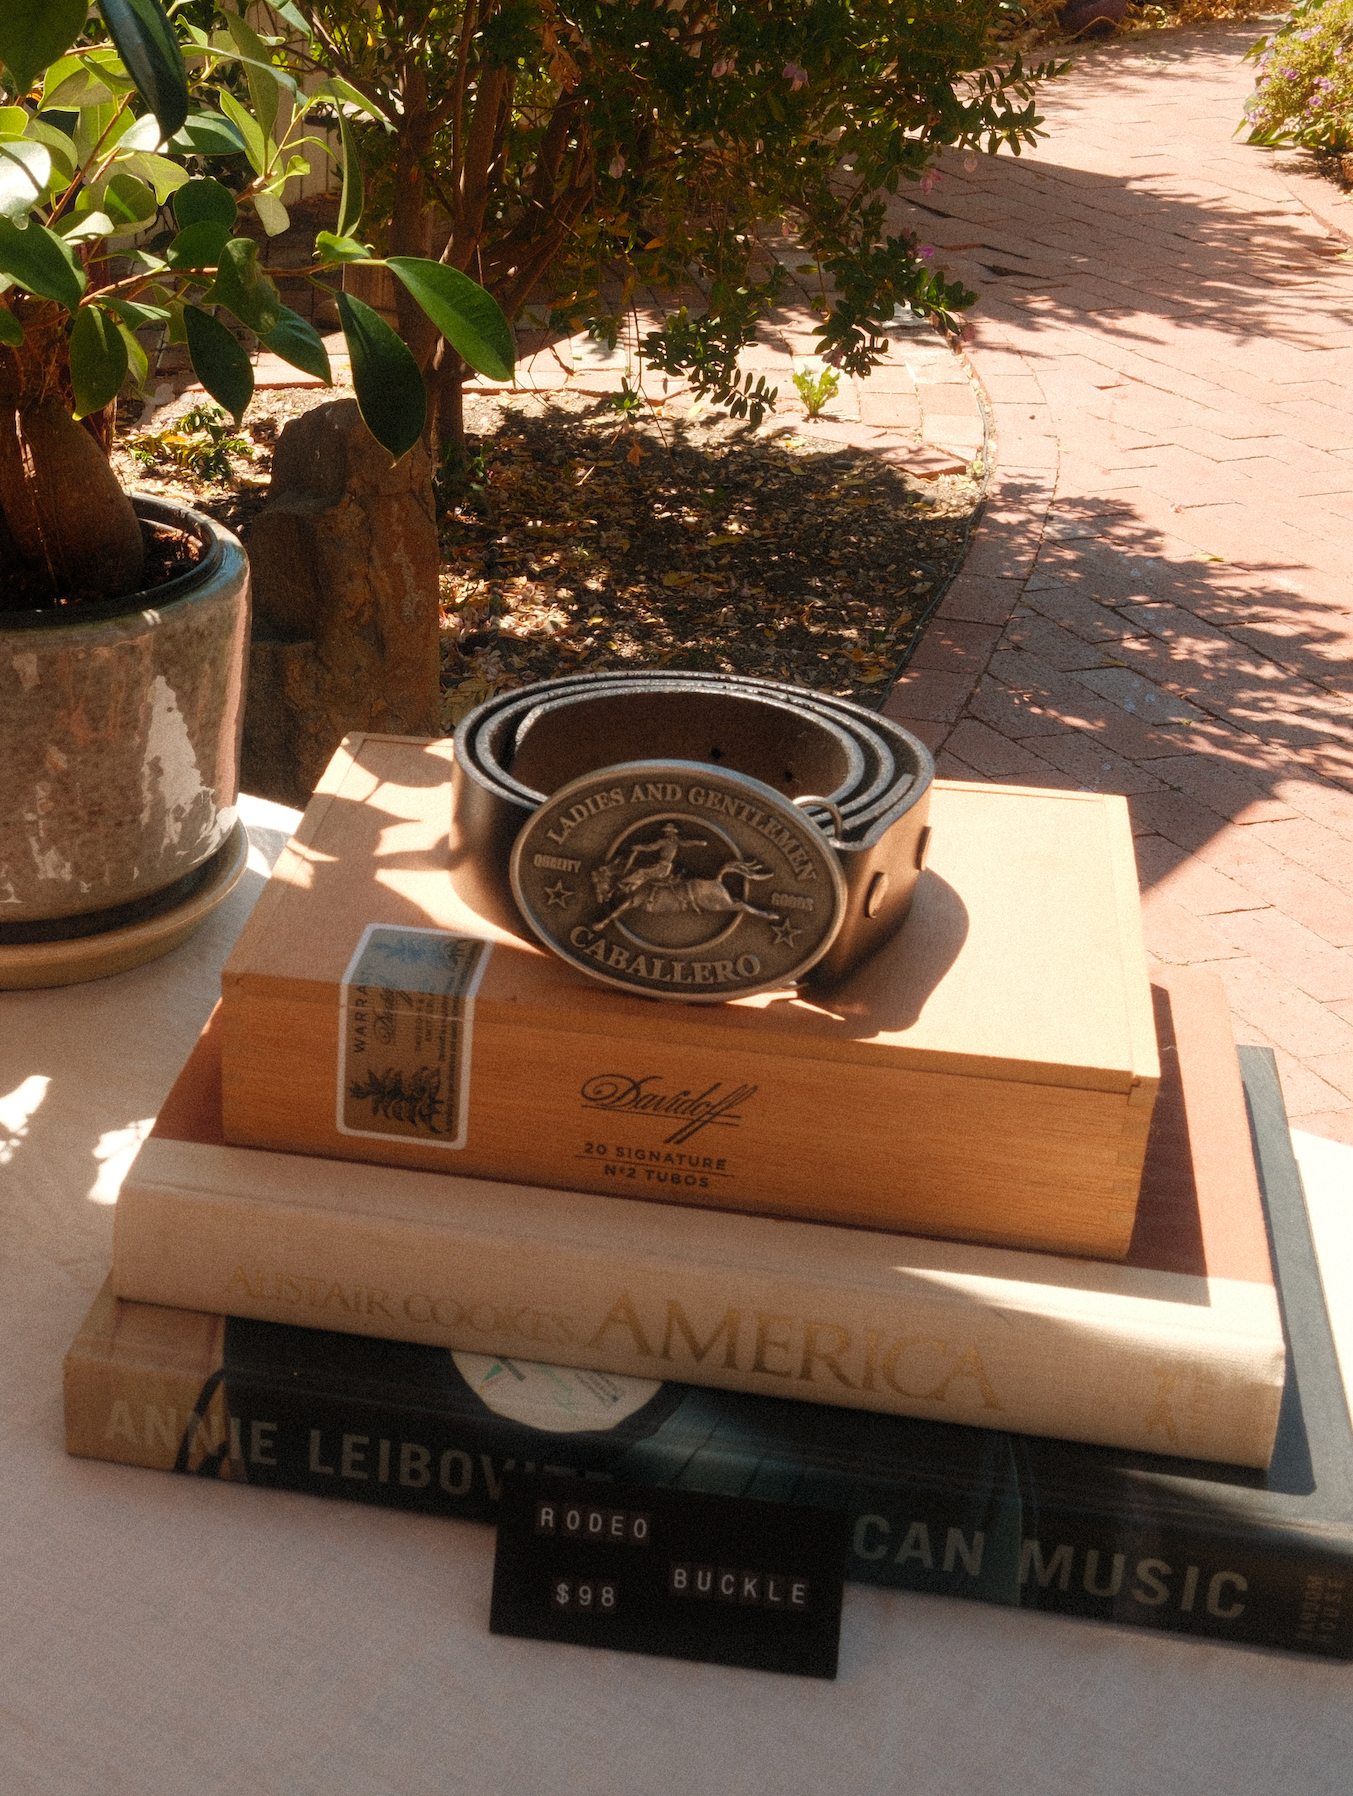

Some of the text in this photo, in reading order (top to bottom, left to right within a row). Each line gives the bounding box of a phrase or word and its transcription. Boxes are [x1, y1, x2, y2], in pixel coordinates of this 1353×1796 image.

[546, 782, 818, 883] LADIES AND GENTLEMEN
[568, 925, 762, 986] CABALLERO
[580, 1073, 759, 1146] Davidoff
[584, 1142, 728, 1171] 20 SIGNATURE
[645, 1168, 710, 1188] TUBOS
[225, 1265, 395, 1321] ALISTAIR
[585, 1290, 1009, 1413] AMERICA
[104, 1398, 278, 1467] ANNIE
[1019, 1538, 1248, 1620] MUSIC
[540, 1506, 648, 1540] RODEO
[555, 1583, 616, 1608] $98
[673, 1567, 807, 1605] BUCKLE
